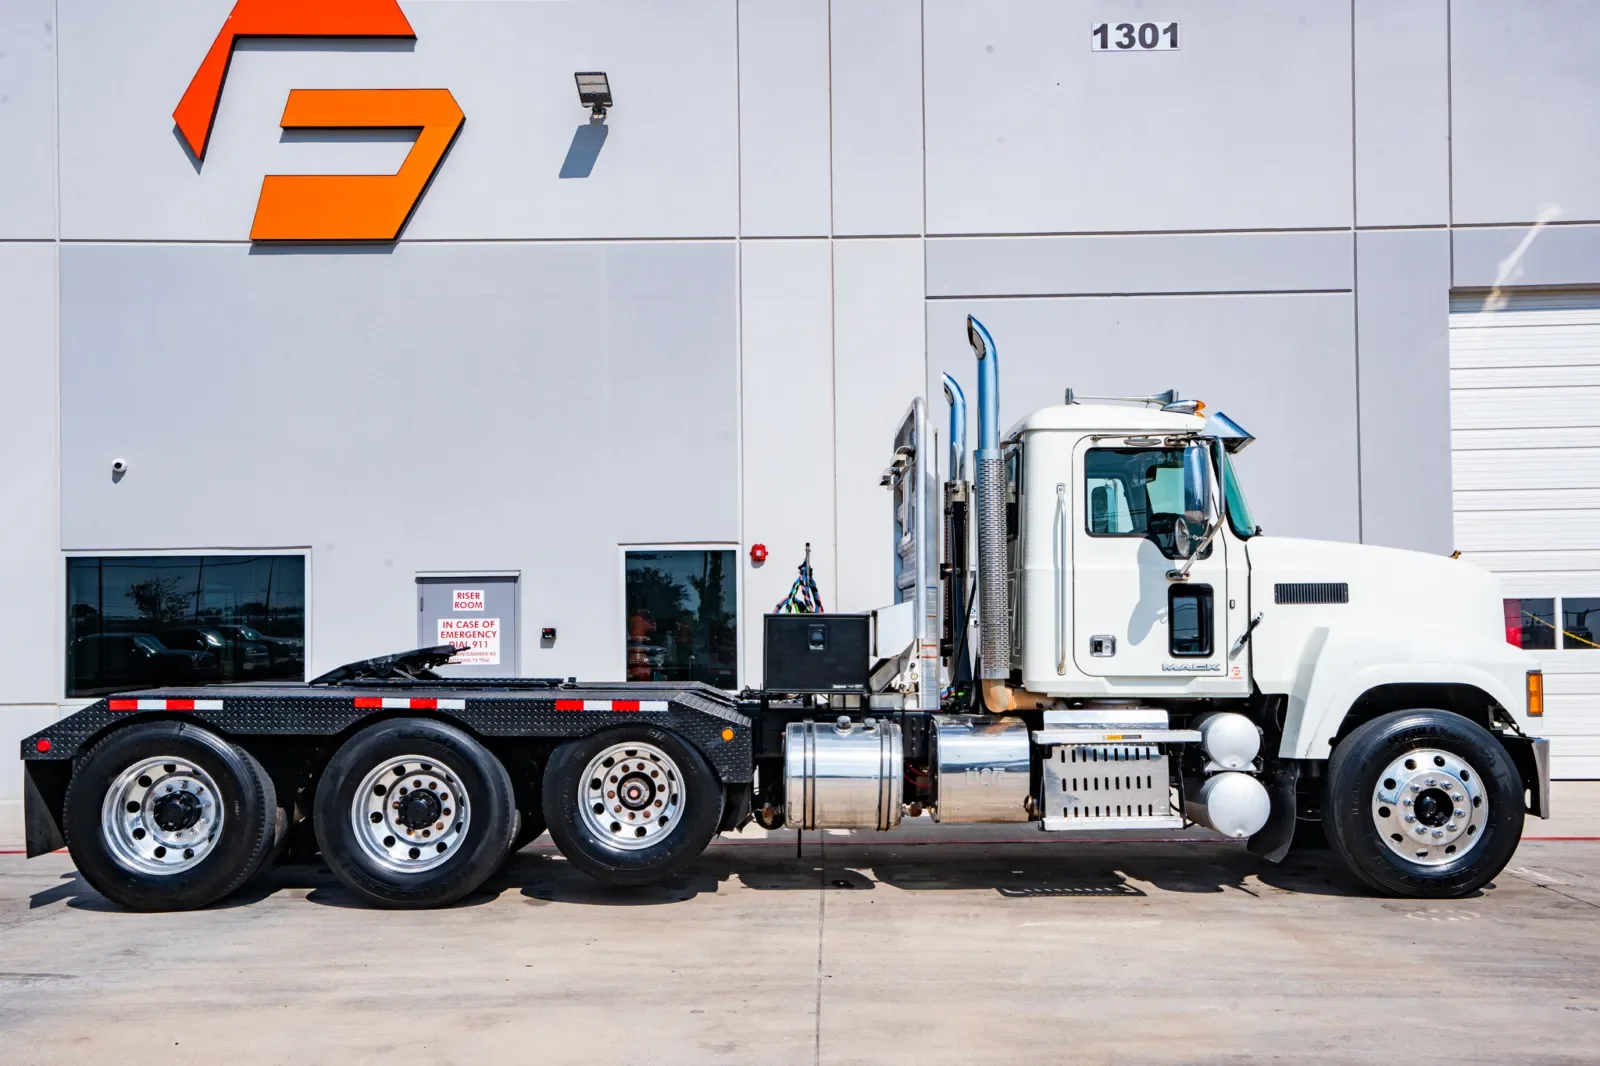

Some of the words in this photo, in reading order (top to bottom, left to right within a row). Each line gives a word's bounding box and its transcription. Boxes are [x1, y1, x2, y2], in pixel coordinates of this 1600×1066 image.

[1093, 22, 1178, 49] 1301
[454, 601, 483, 609] ROOM
[442, 621, 453, 629] IN
[1161, 663, 1221, 671] MACK
